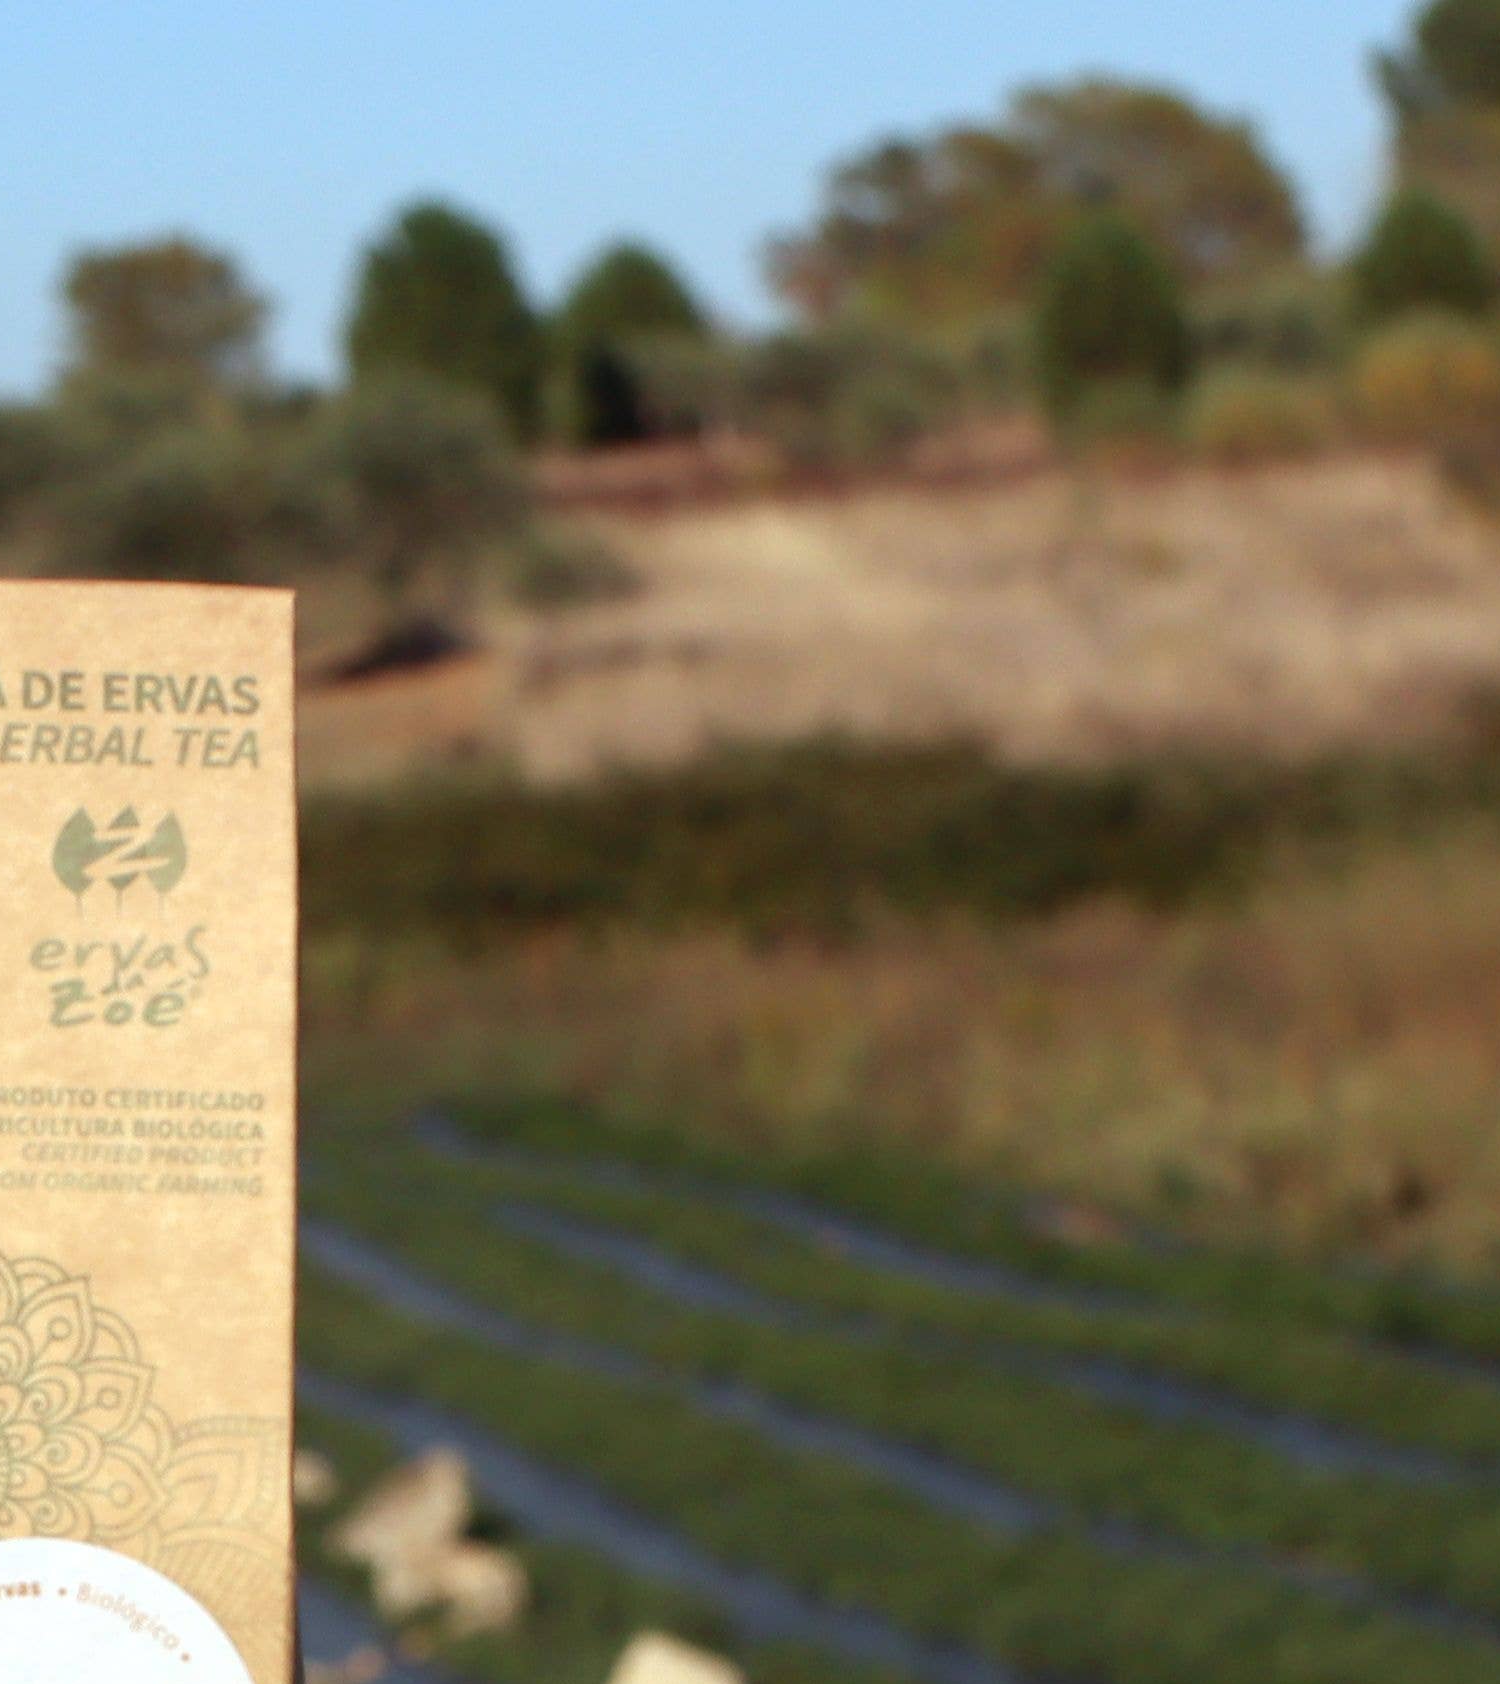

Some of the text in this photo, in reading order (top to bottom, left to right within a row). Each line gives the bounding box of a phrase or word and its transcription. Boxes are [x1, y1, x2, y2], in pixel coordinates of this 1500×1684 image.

[22, 671, 87, 710] DE
[103, 674, 260, 714] ERVAS
[173, 728, 260, 768] TEA
[104, 1088, 265, 1112] CERTIFICADO
[131, 1115, 264, 1140] BIOLÓGICA
[21, 1142, 264, 1168] CERTIFIED PRODUCT
[43, 1170, 152, 1194] ORGANIC
[156, 1174, 263, 1198] FARMING
[76, 1582, 181, 1650] Biológico
